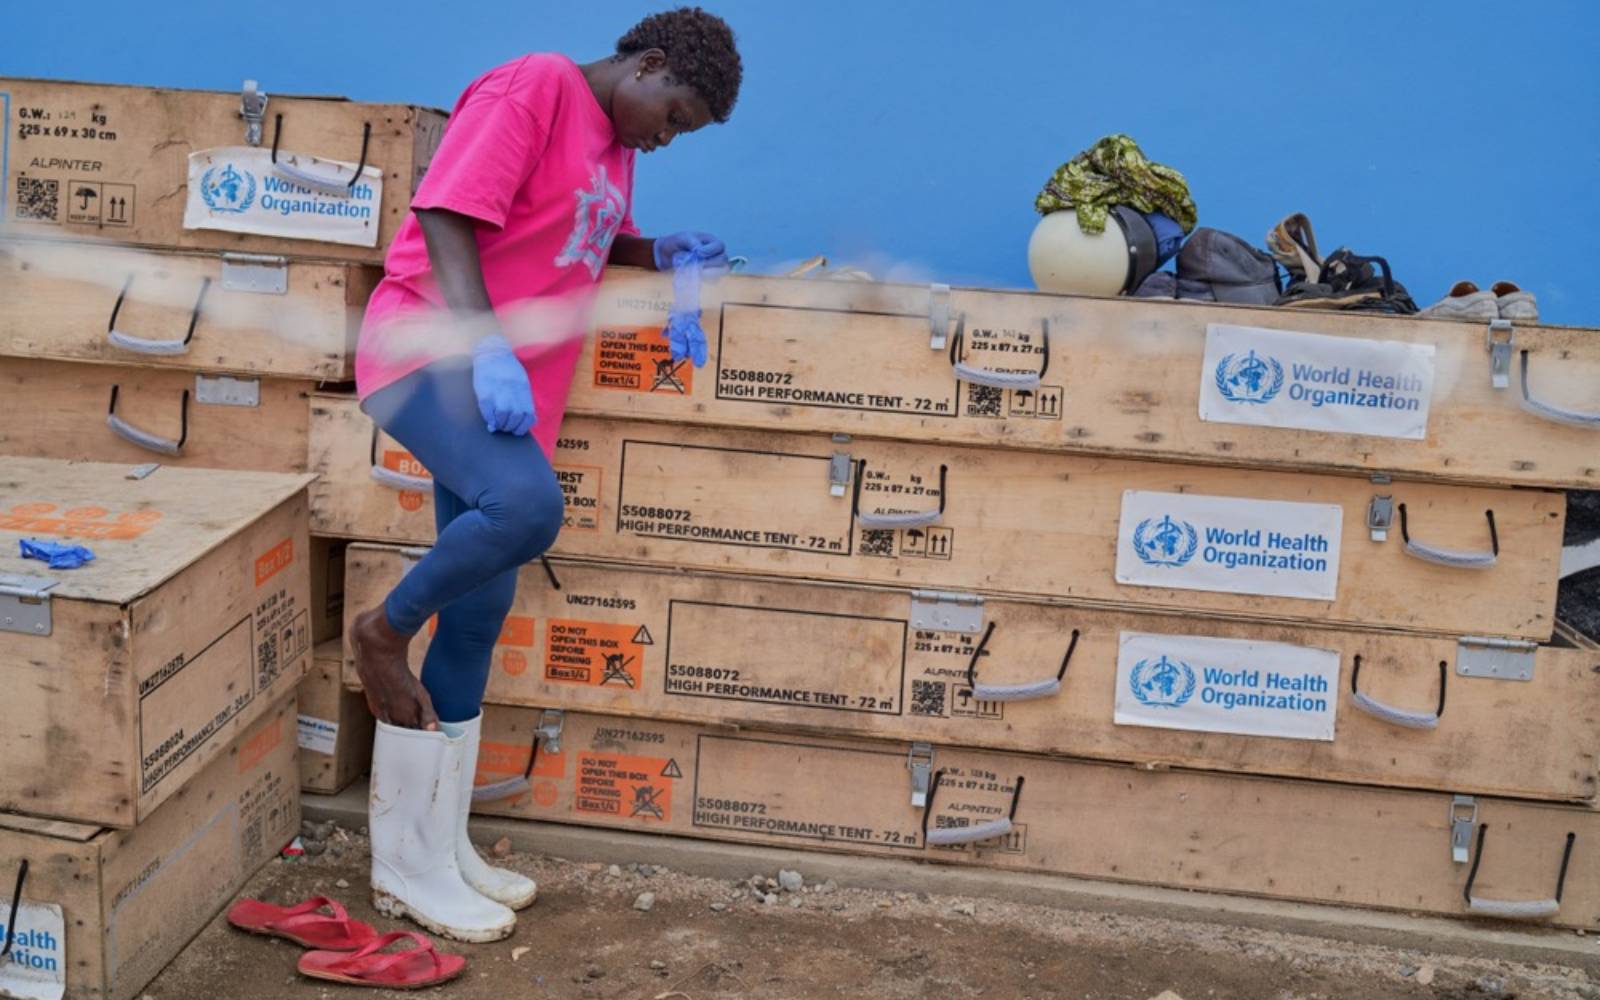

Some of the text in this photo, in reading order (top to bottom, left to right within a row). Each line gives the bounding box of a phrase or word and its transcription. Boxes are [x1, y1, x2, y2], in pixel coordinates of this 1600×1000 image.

[91, 112, 107, 126] kg
[19, 124, 117, 140] 225 x 69 x 30 cm
[30, 157, 103, 171] ALPINTER
[261, 193, 371, 218] Organization
[618, 332, 637, 340] NOT
[1018, 332, 1030, 342] kg
[601, 340, 670, 353] OPEN THIS BOX
[971, 341, 988, 350] 225
[601, 351, 635, 360] BEFORE
[600, 360, 641, 370] OPENING
[720, 369, 793, 385] S5088072
[1292, 363, 1422, 393] World Health
[719, 384, 754, 397] HIGH
[758, 387, 864, 405] PERFORMANCE
[867, 393, 903, 408] TENT
[914, 395, 931, 410] 72
[1289, 383, 1420, 411] Organization
[556, 438, 589, 450] 62595
[555, 471, 584, 483] IRST
[910, 474, 922, 484] kg
[573, 496, 596, 508] BOX
[622, 505, 692, 521] S5088072
[620, 520, 654, 534] HIGH
[657, 523, 760, 543] PERFORMANCE
[764, 531, 799, 546] TENT
[808, 536, 826, 549] 72
[1205, 527, 1328, 553] World Health
[1203, 546, 1327, 572] Organization
[566, 594, 636, 610] UN27162595
[551, 625, 587, 635] DO NOT
[551, 635, 576, 644] OPEN
[600, 640, 619, 648] BOX
[961, 634, 972, 644] kg
[550, 644, 585, 655] BEFORE
[550, 654, 591, 665] OPENING
[669, 664, 740, 681] S5088072
[1203, 668, 1328, 693] World Health
[668, 679, 703, 692] HIGH
[706, 682, 810, 703] PERFORMANCE
[813, 692, 849, 706] TENT
[859, 696, 876, 709] 72
[1201, 686, 1327, 713] Organization
[596, 727, 665, 744] UN27162595
[580, 786, 621, 797] OPENING
[697, 797, 767, 814] S5088072
[948, 802, 1003, 814] ALPINTER
[696, 812, 730, 826] HIGH
[733, 815, 835, 836] PERFORMANCE
[838, 826, 873, 840] TENT
[883, 830, 901, 843] 72
